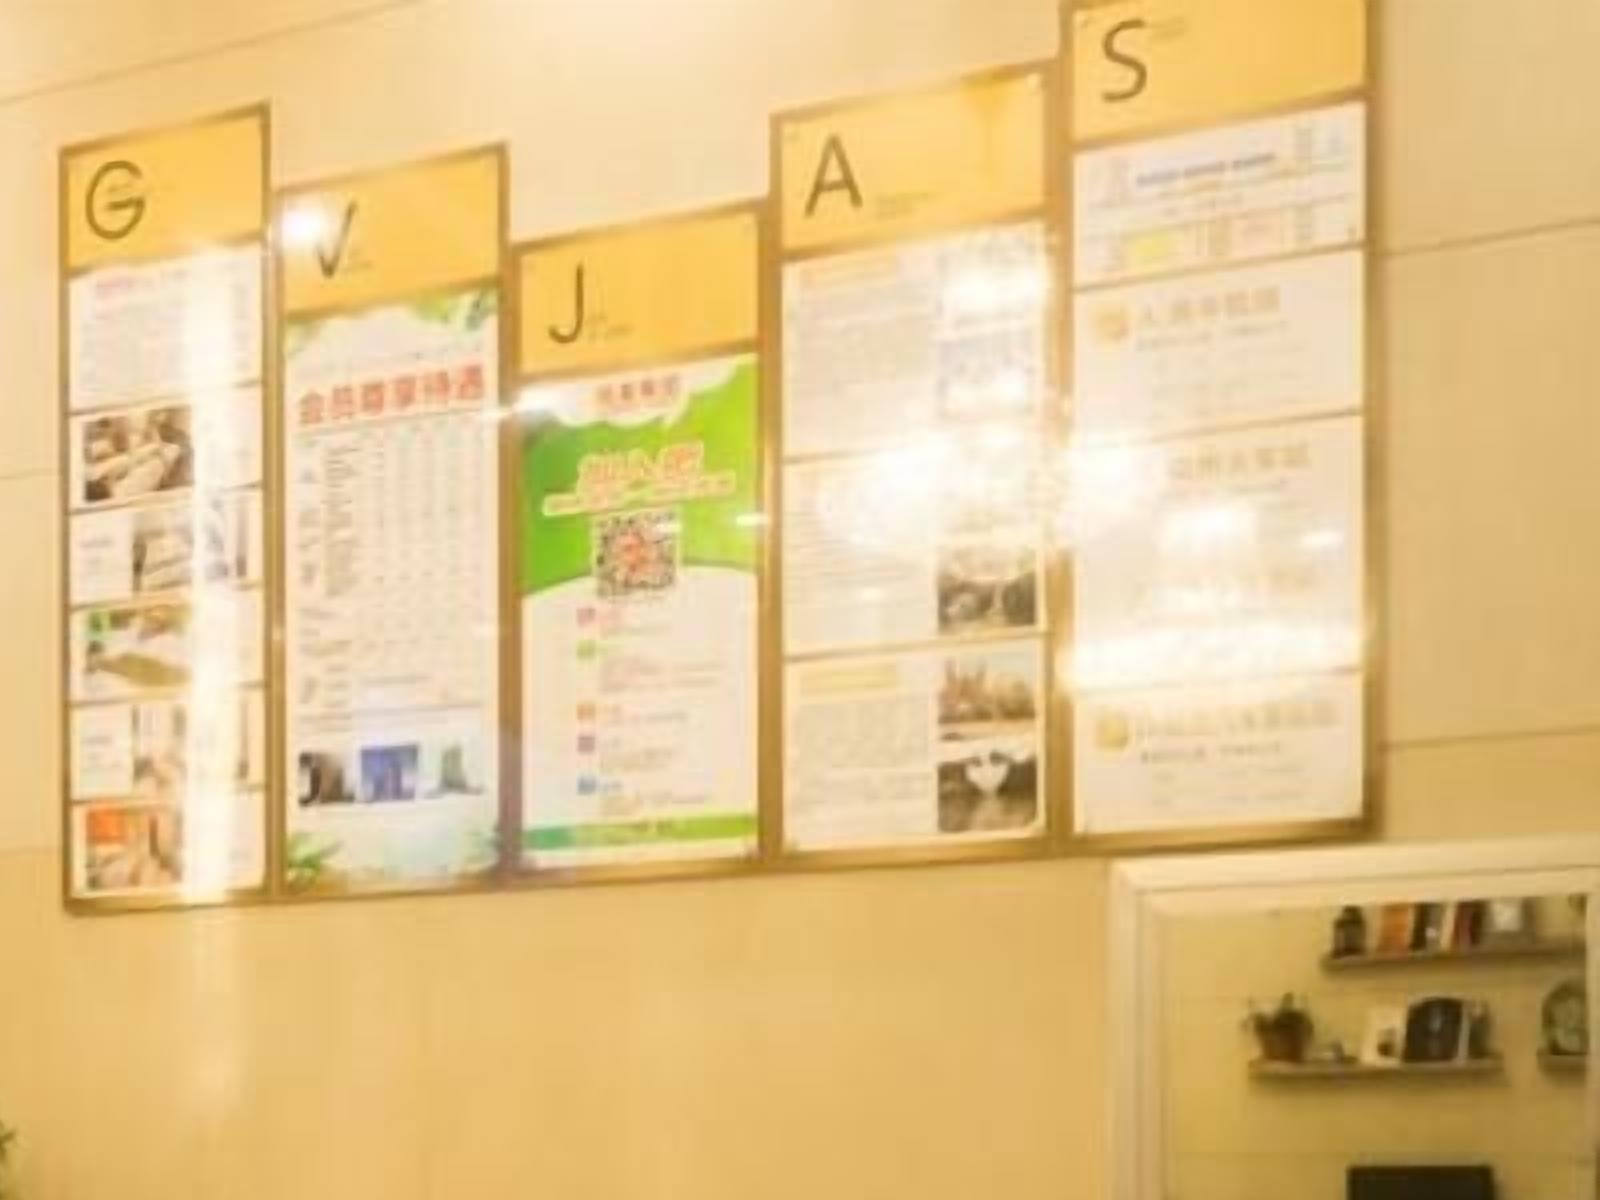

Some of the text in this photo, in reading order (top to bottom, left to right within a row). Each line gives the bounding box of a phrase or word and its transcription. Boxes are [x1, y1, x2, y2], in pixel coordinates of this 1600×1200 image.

[1101, 18, 1148, 103] S
[84, 159, 146, 240] G
[804, 133, 864, 218] A
[308, 200, 358, 279] V
[548, 263, 585, 344] J
